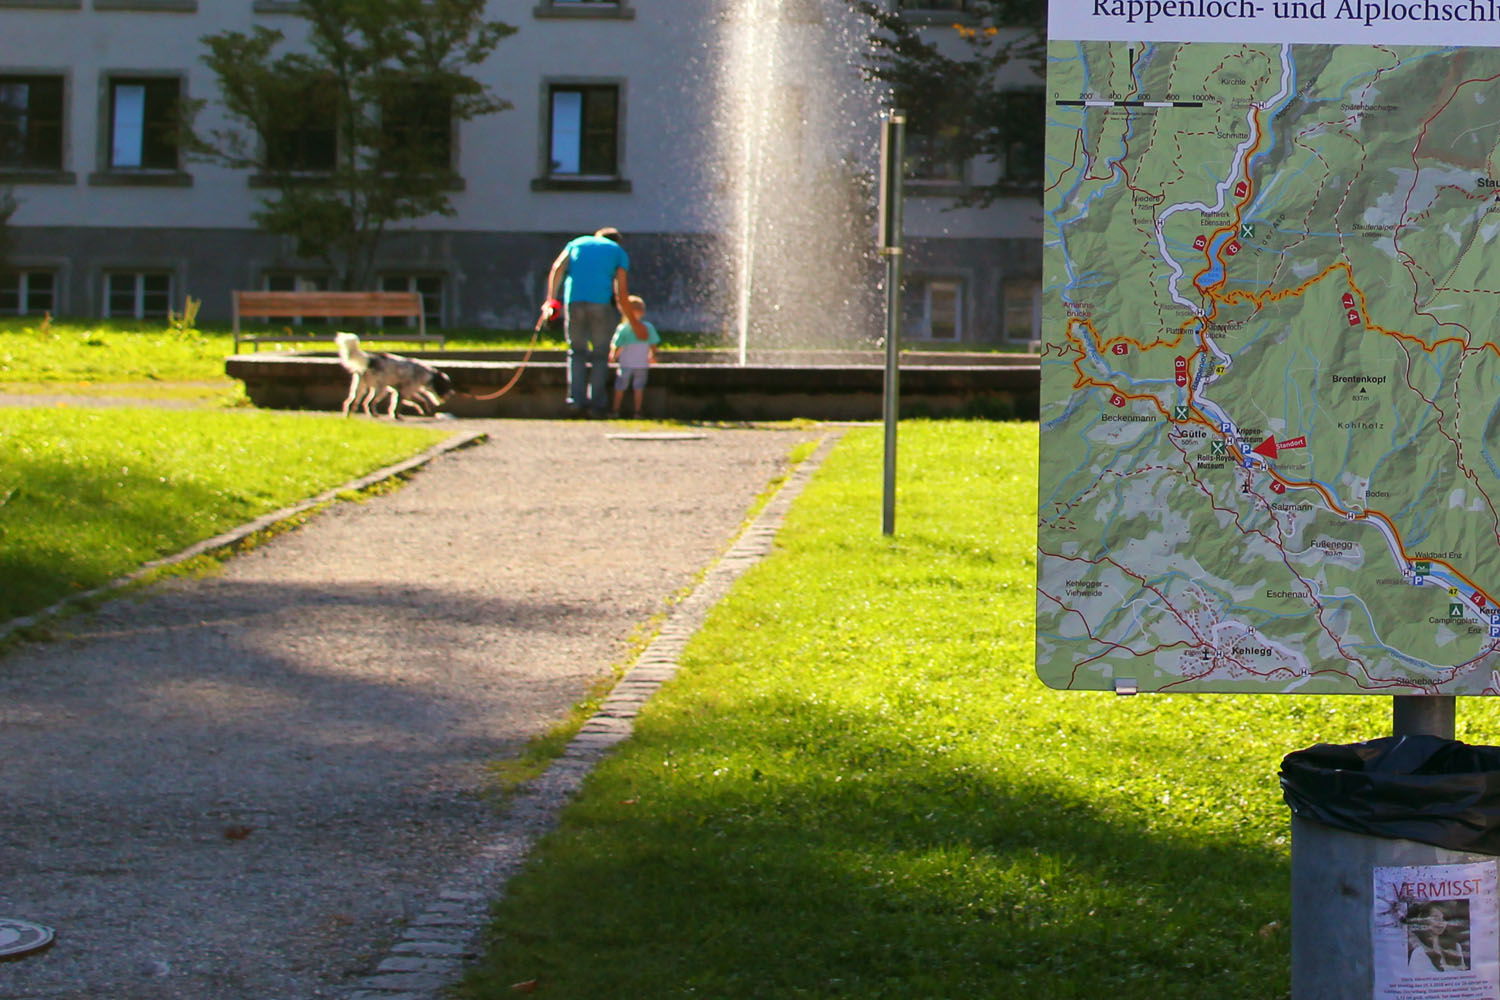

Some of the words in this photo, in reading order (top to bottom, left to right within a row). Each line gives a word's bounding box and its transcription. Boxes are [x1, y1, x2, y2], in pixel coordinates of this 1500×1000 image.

[1116, 345, 1124, 354] 5
[1332, 375, 1386, 384] Brentenkopf
[1114, 396, 1120, 405] 5
[1102, 414, 1156, 422] Beckenmann
[1181, 430, 1207, 439] Gütle
[1276, 439, 1304, 450] Standort
[1272, 502, 1312, 511] Salzmann
[1066, 580, 1102, 588] Kehlegger
[1266, 590, 1308, 598] Eschenau
[1429, 616, 1478, 624] Campingplatz
[1232, 646, 1272, 656] Kehlegg
[1392, 878, 1482, 898] VERMISST
